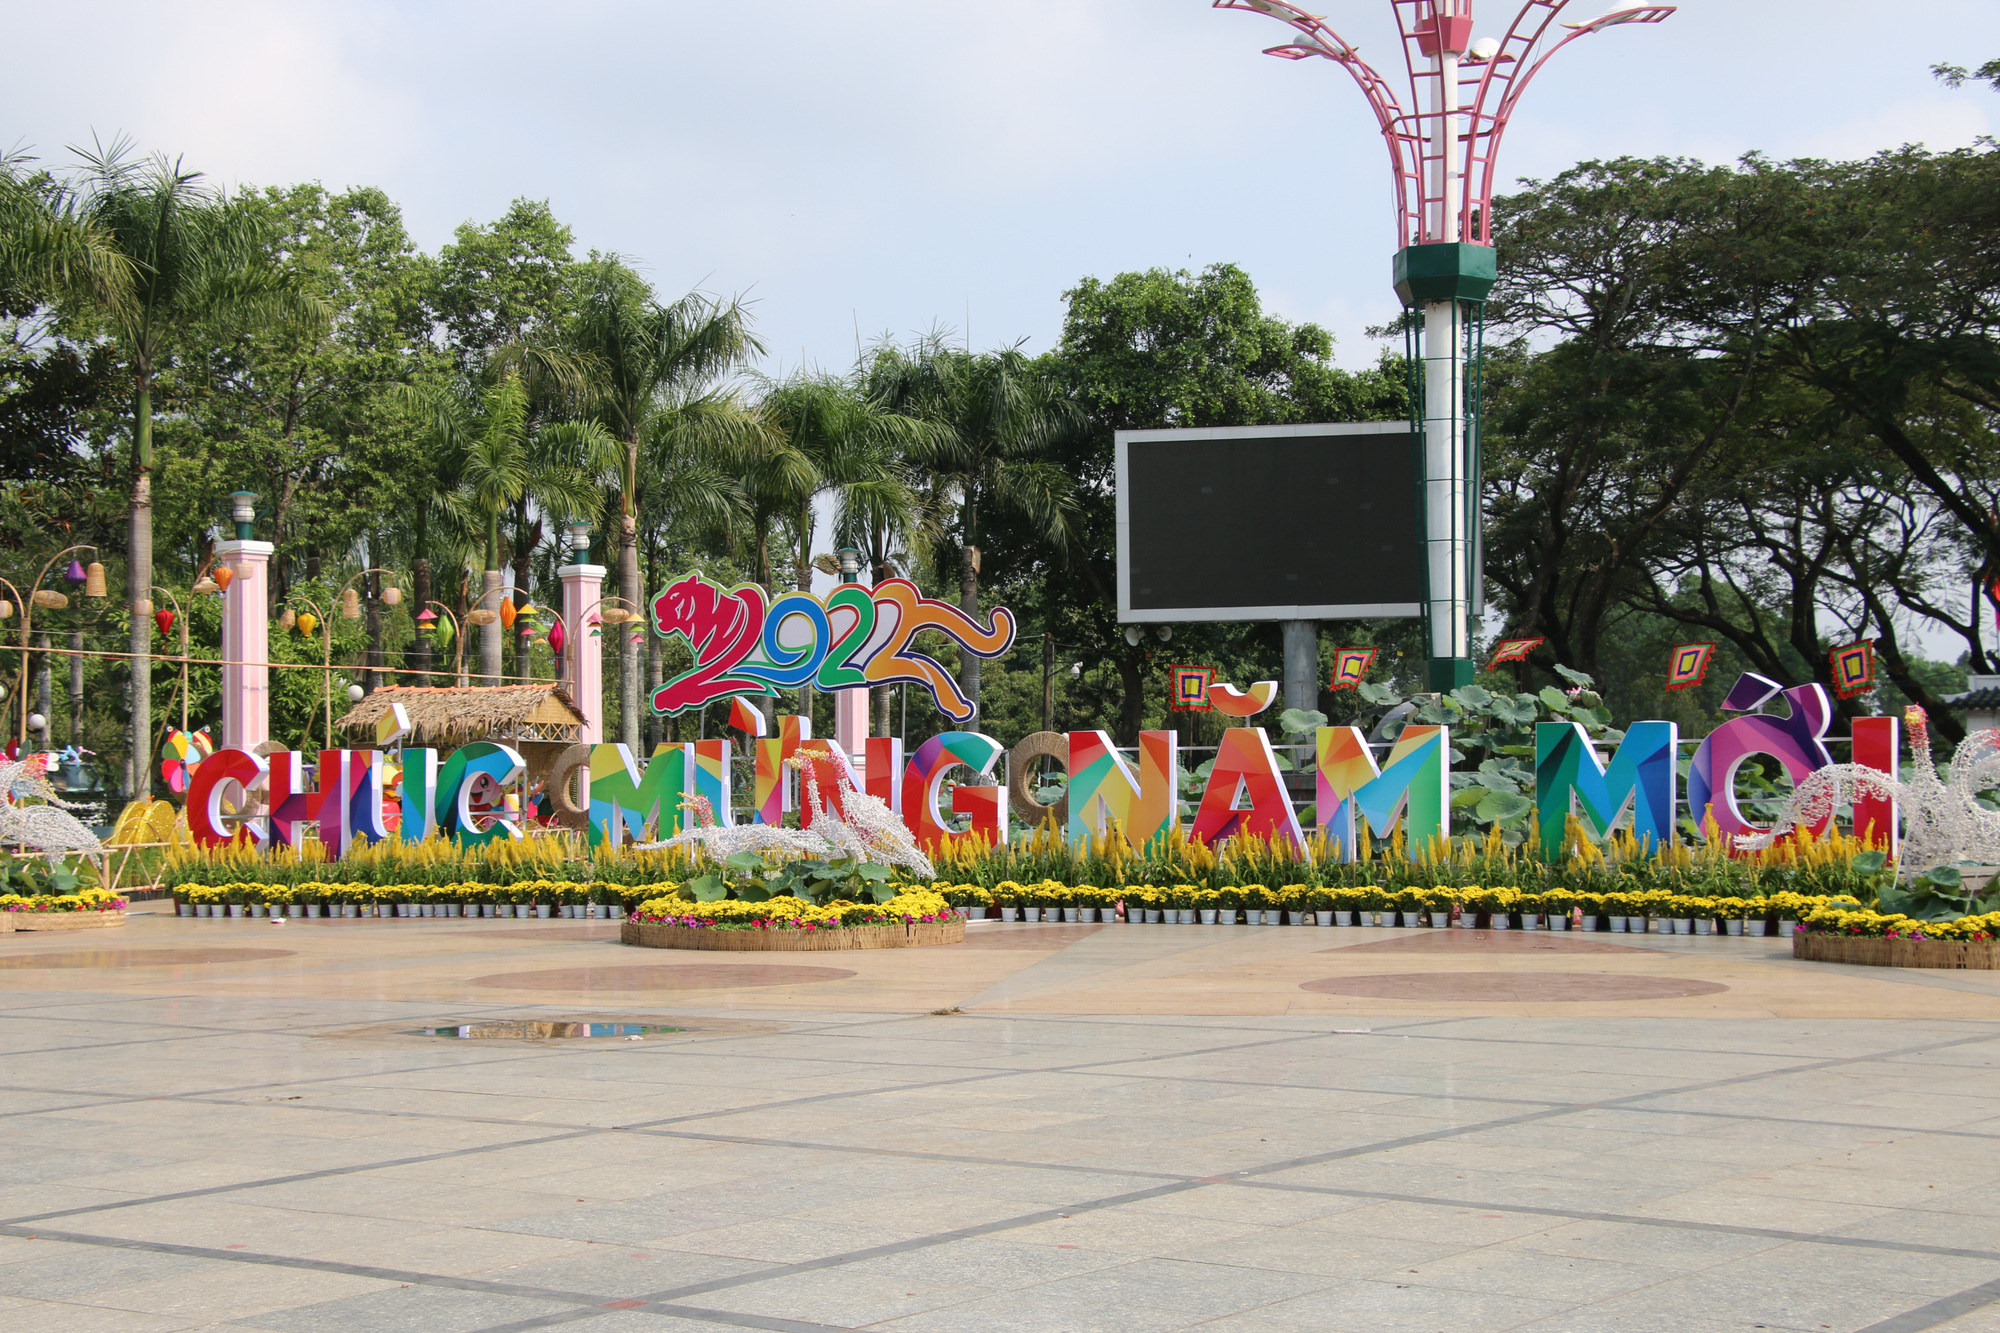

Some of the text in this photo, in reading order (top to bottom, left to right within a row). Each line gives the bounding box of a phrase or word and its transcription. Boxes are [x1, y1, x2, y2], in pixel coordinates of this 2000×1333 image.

[650, 569, 1017, 723] 2022
[187, 671, 1900, 865] CHÚC MỪNG NĂM MỚI
